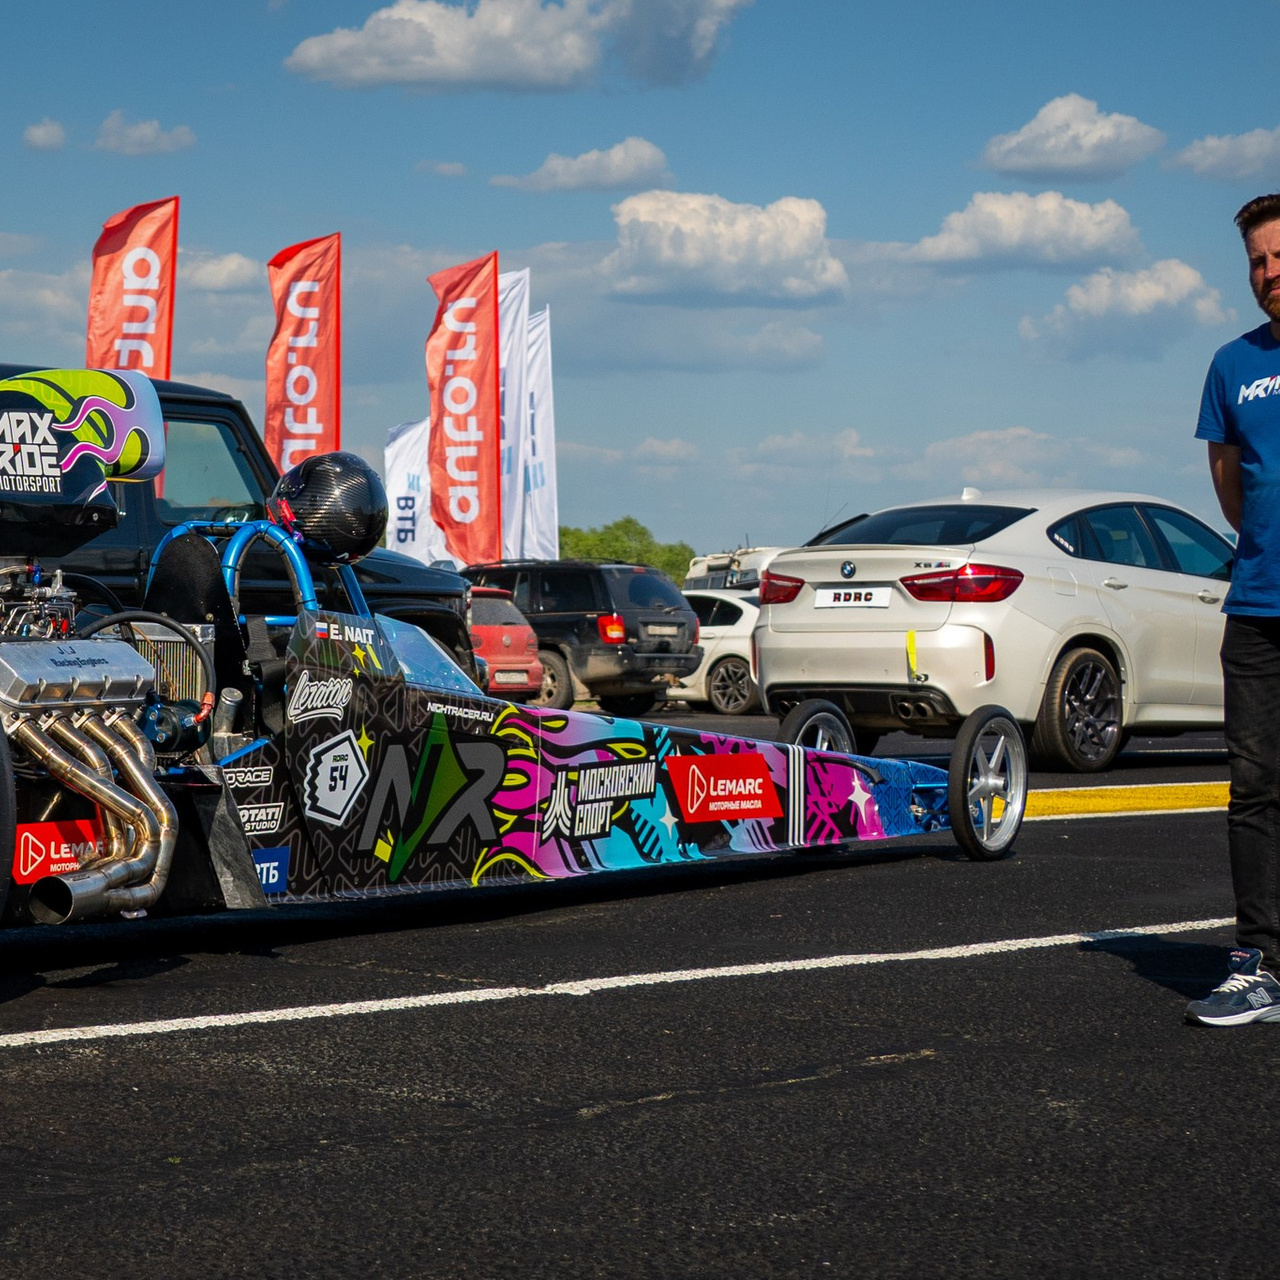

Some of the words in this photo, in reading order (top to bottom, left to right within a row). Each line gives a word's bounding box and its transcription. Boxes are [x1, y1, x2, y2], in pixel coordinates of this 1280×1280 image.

[396, 496, 416, 544] ВТБ
[832, 591, 873, 602] RDRC
[344, 626, 374, 645] NAIT
[50, 658, 81, 668] Racing
[78, 657, 110, 668] Engines
[426, 701, 494, 722] NIGHTRACER.RU
[328, 765, 349, 792] 54
[577, 755, 657, 802] МОСКОВСКИЙ
[710, 776, 763, 796] LEMARC
[239, 807, 280, 822] OTATI
[573, 801, 613, 837] СПОРТ
[244, 820, 277, 831] STUDIO
[49, 862, 81, 872] МОТОРН
